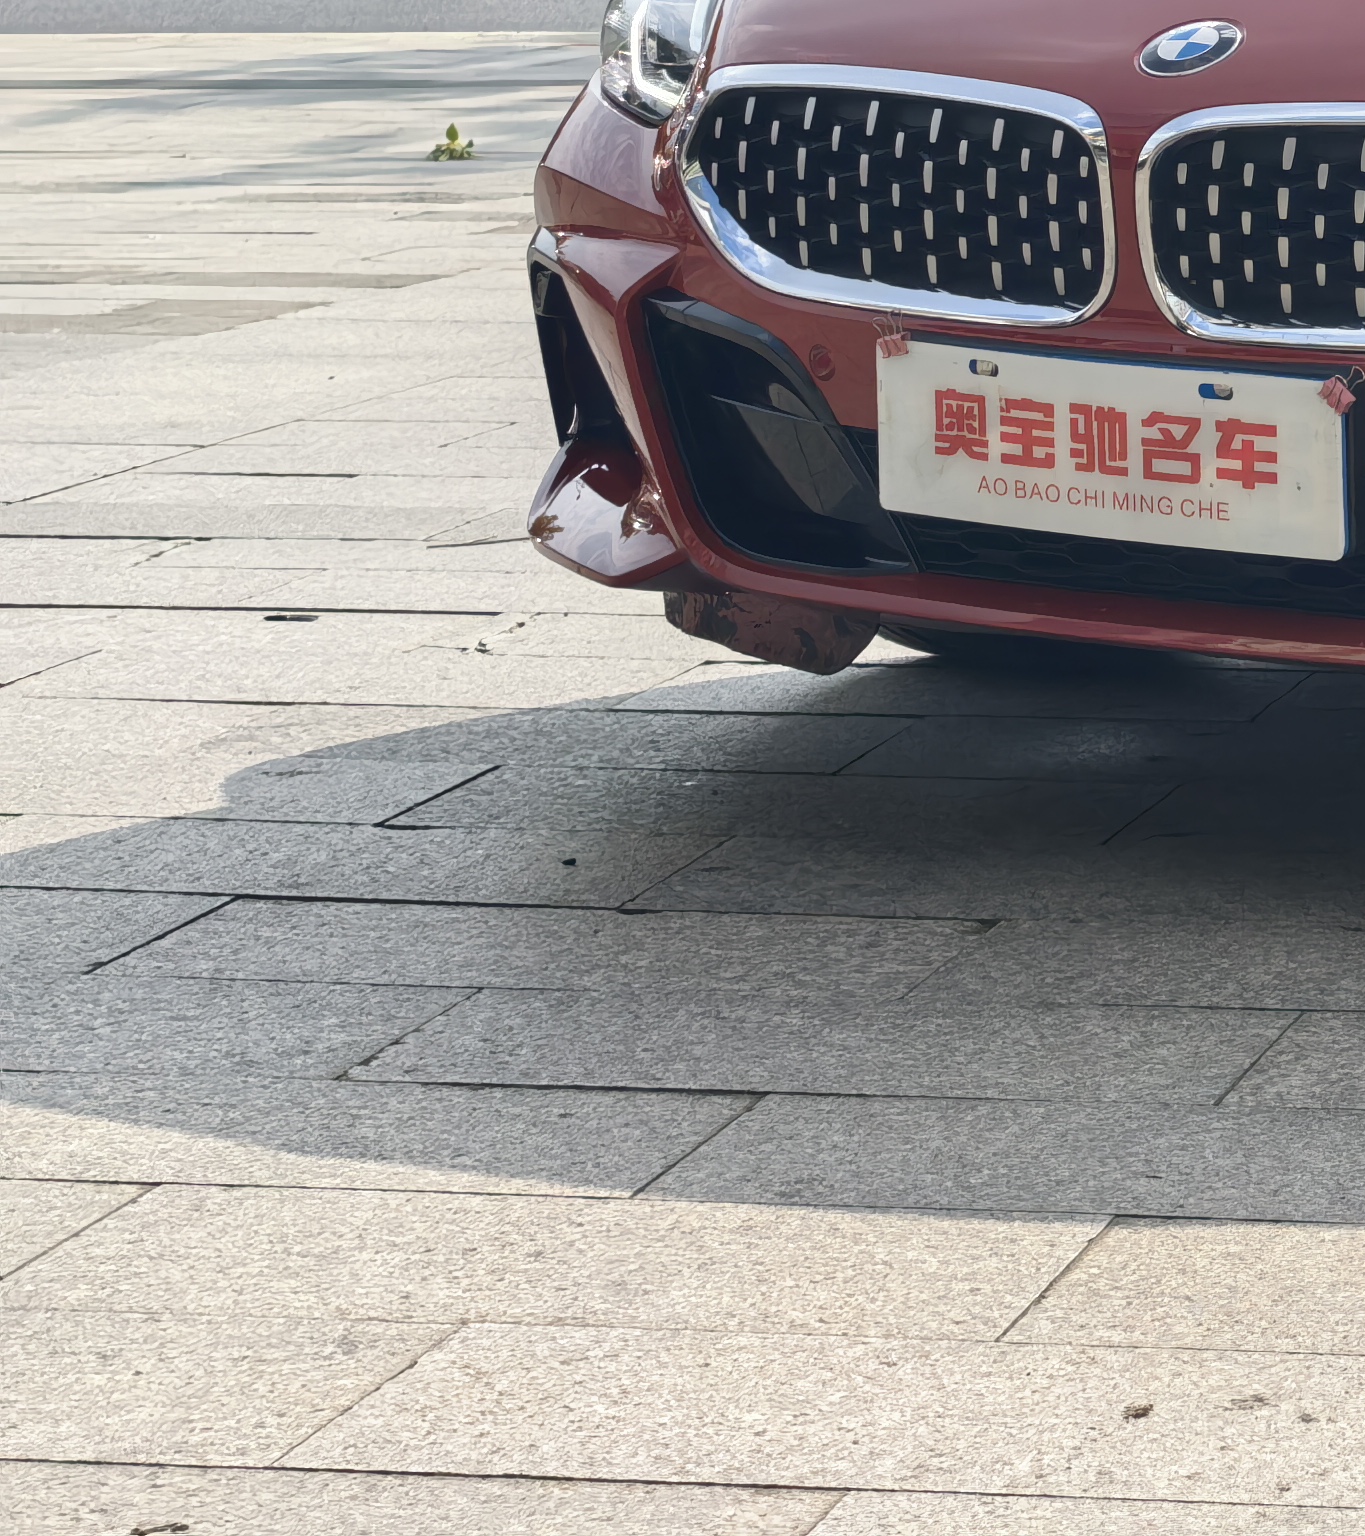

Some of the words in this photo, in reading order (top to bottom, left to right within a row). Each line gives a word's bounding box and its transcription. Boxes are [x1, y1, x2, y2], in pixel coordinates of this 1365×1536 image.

[934, 388, 1278, 490] 奥宝驰名车
[977, 475, 1008, 496] AO
[1014, 480, 1061, 503] BAO
[1067, 486, 1106, 509] CHI
[1113, 491, 1174, 516] MING
[1180, 498, 1231, 521] CHE
